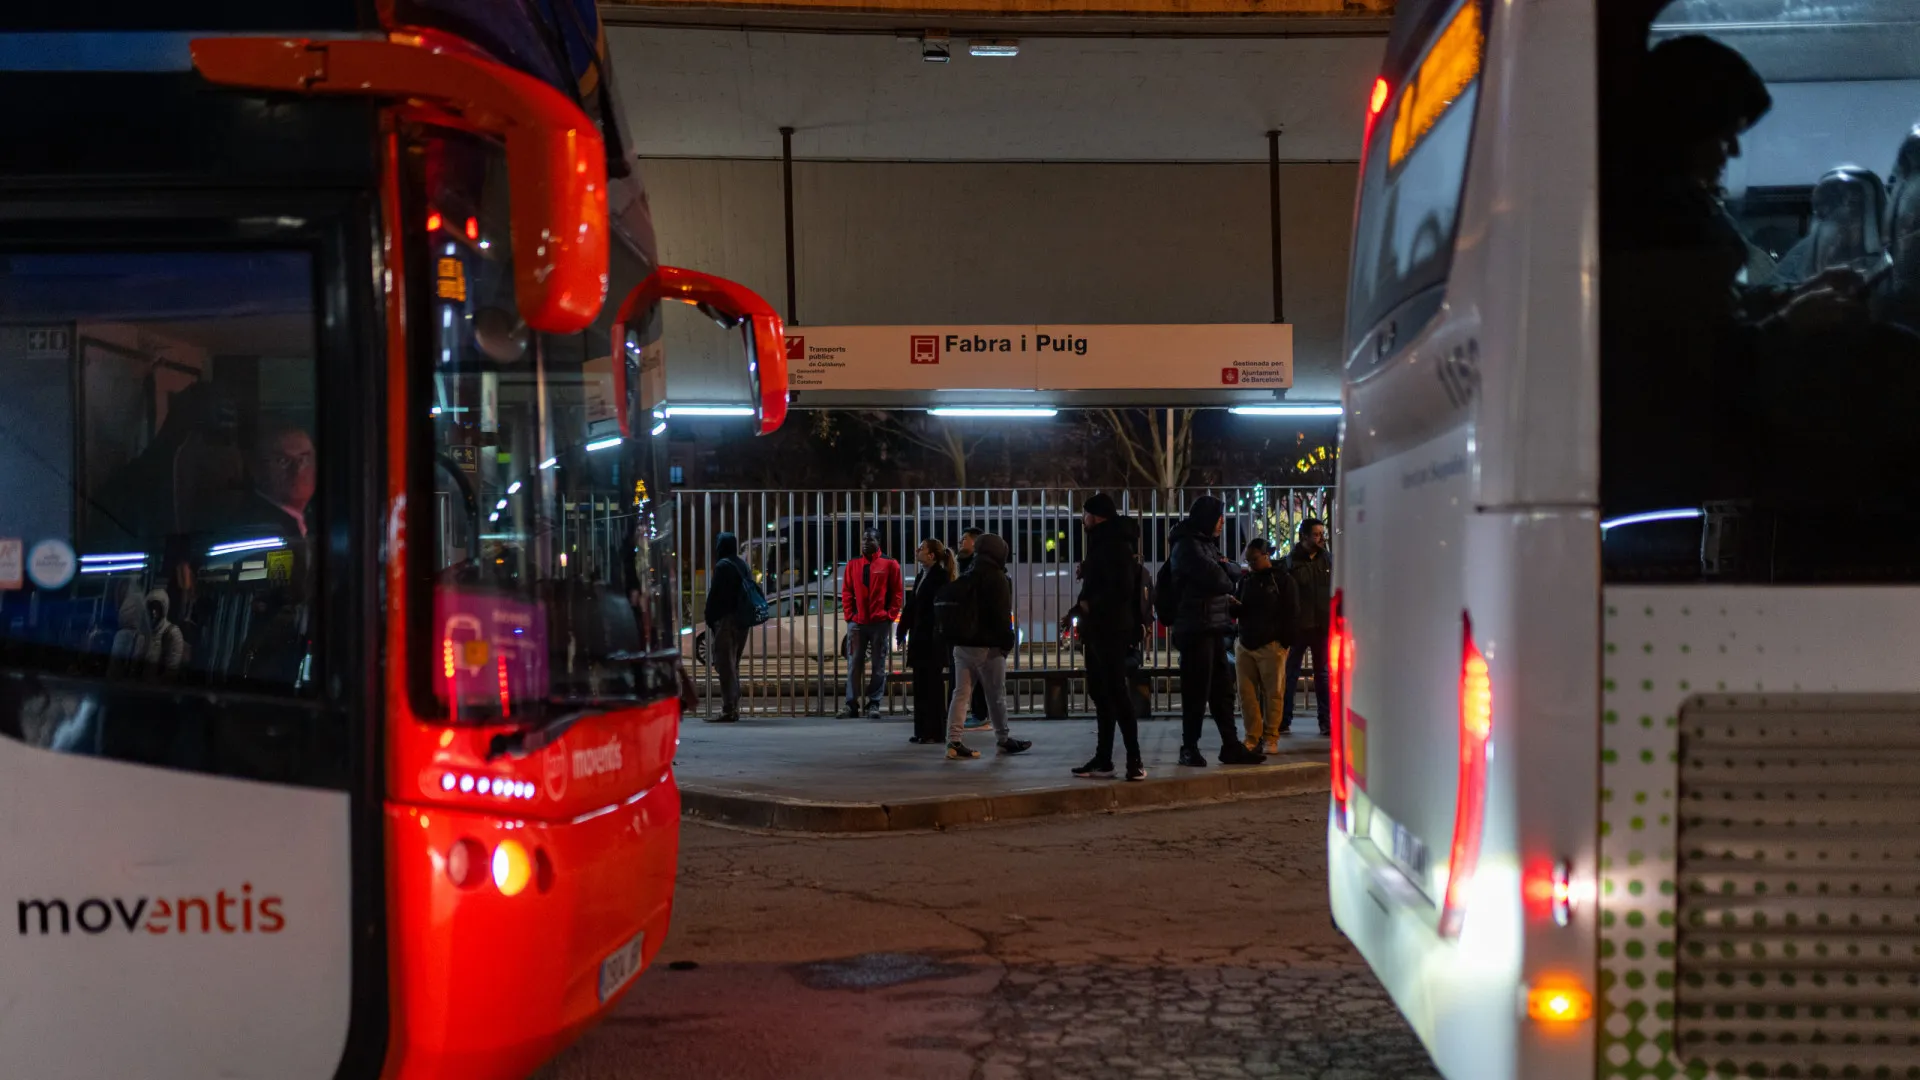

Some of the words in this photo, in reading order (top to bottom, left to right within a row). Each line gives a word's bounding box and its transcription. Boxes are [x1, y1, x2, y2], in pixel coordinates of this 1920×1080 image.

[945, 335, 1012, 353] Fabra
[1021, 335, 1026, 353] i
[1036, 334, 1088, 356] Puig
[17, 881, 286, 935] moventis
